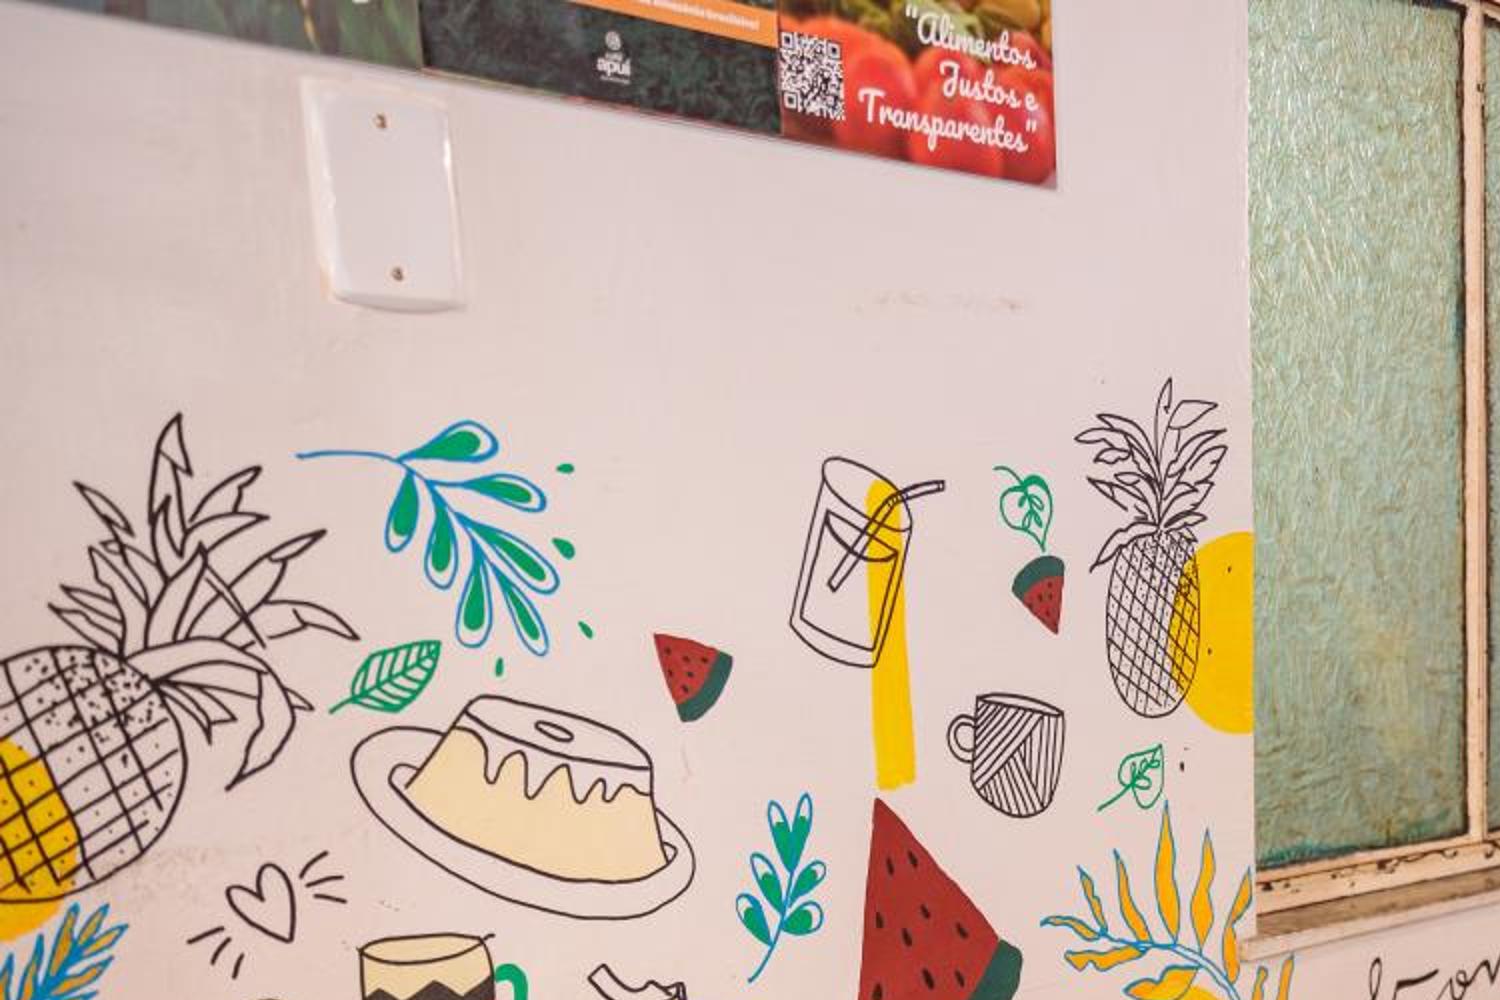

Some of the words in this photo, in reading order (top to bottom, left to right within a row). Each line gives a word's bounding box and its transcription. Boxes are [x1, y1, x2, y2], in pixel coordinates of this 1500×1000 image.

[905, 4, 1037, 70] "Alimentos
[939, 60, 1021, 109] Justos
[1024, 92, 1039, 112] e
[858, 87, 1038, 151] Transparentes"
